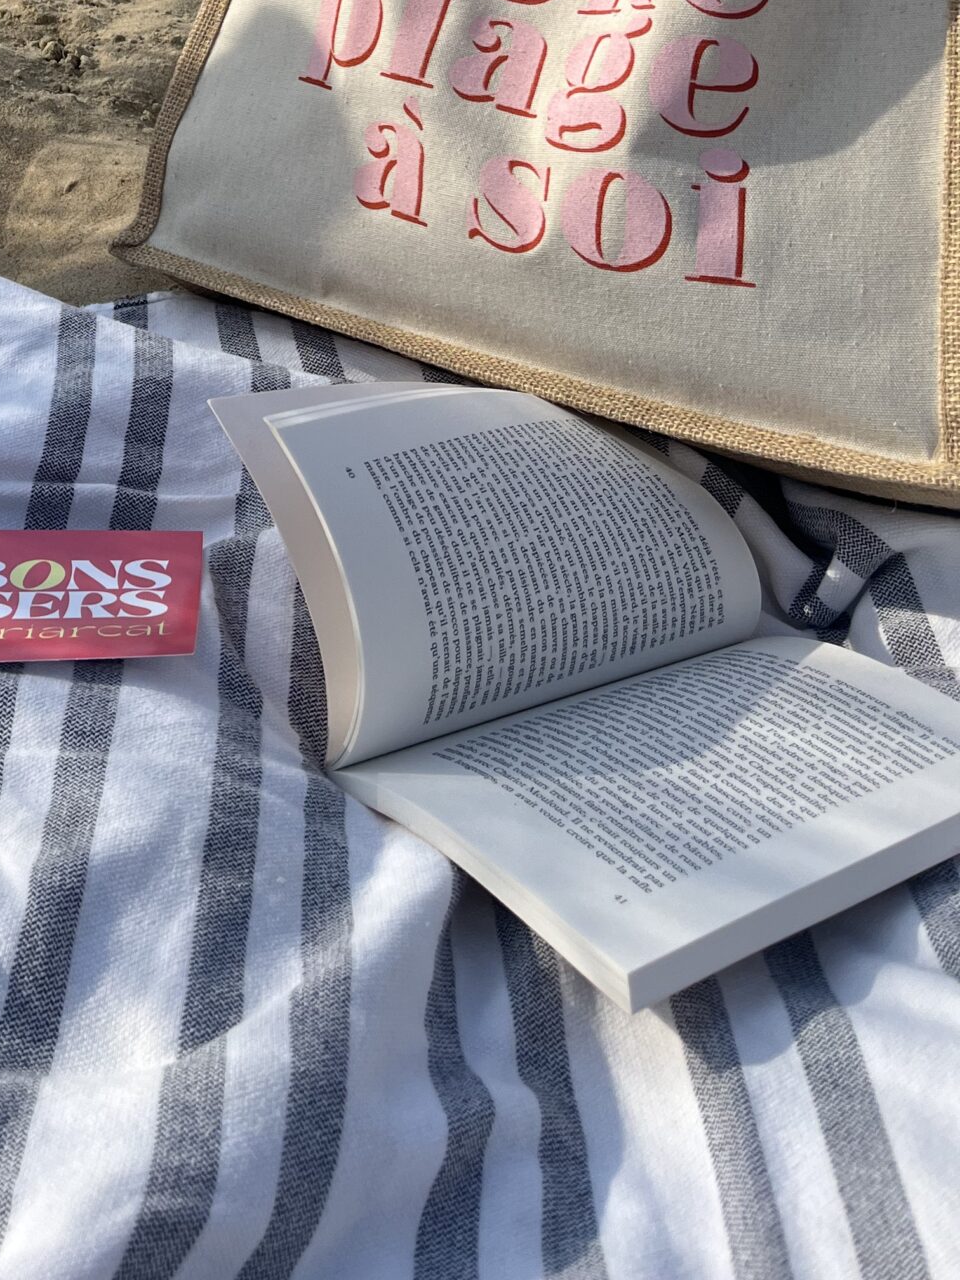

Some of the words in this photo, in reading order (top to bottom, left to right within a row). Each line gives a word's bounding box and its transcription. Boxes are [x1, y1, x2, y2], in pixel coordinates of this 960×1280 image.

[354, 96, 428, 227] à
[467, 148, 756, 287] soi
[344, 466, 356, 480] 40
[613, 893, 628, 905] 41
